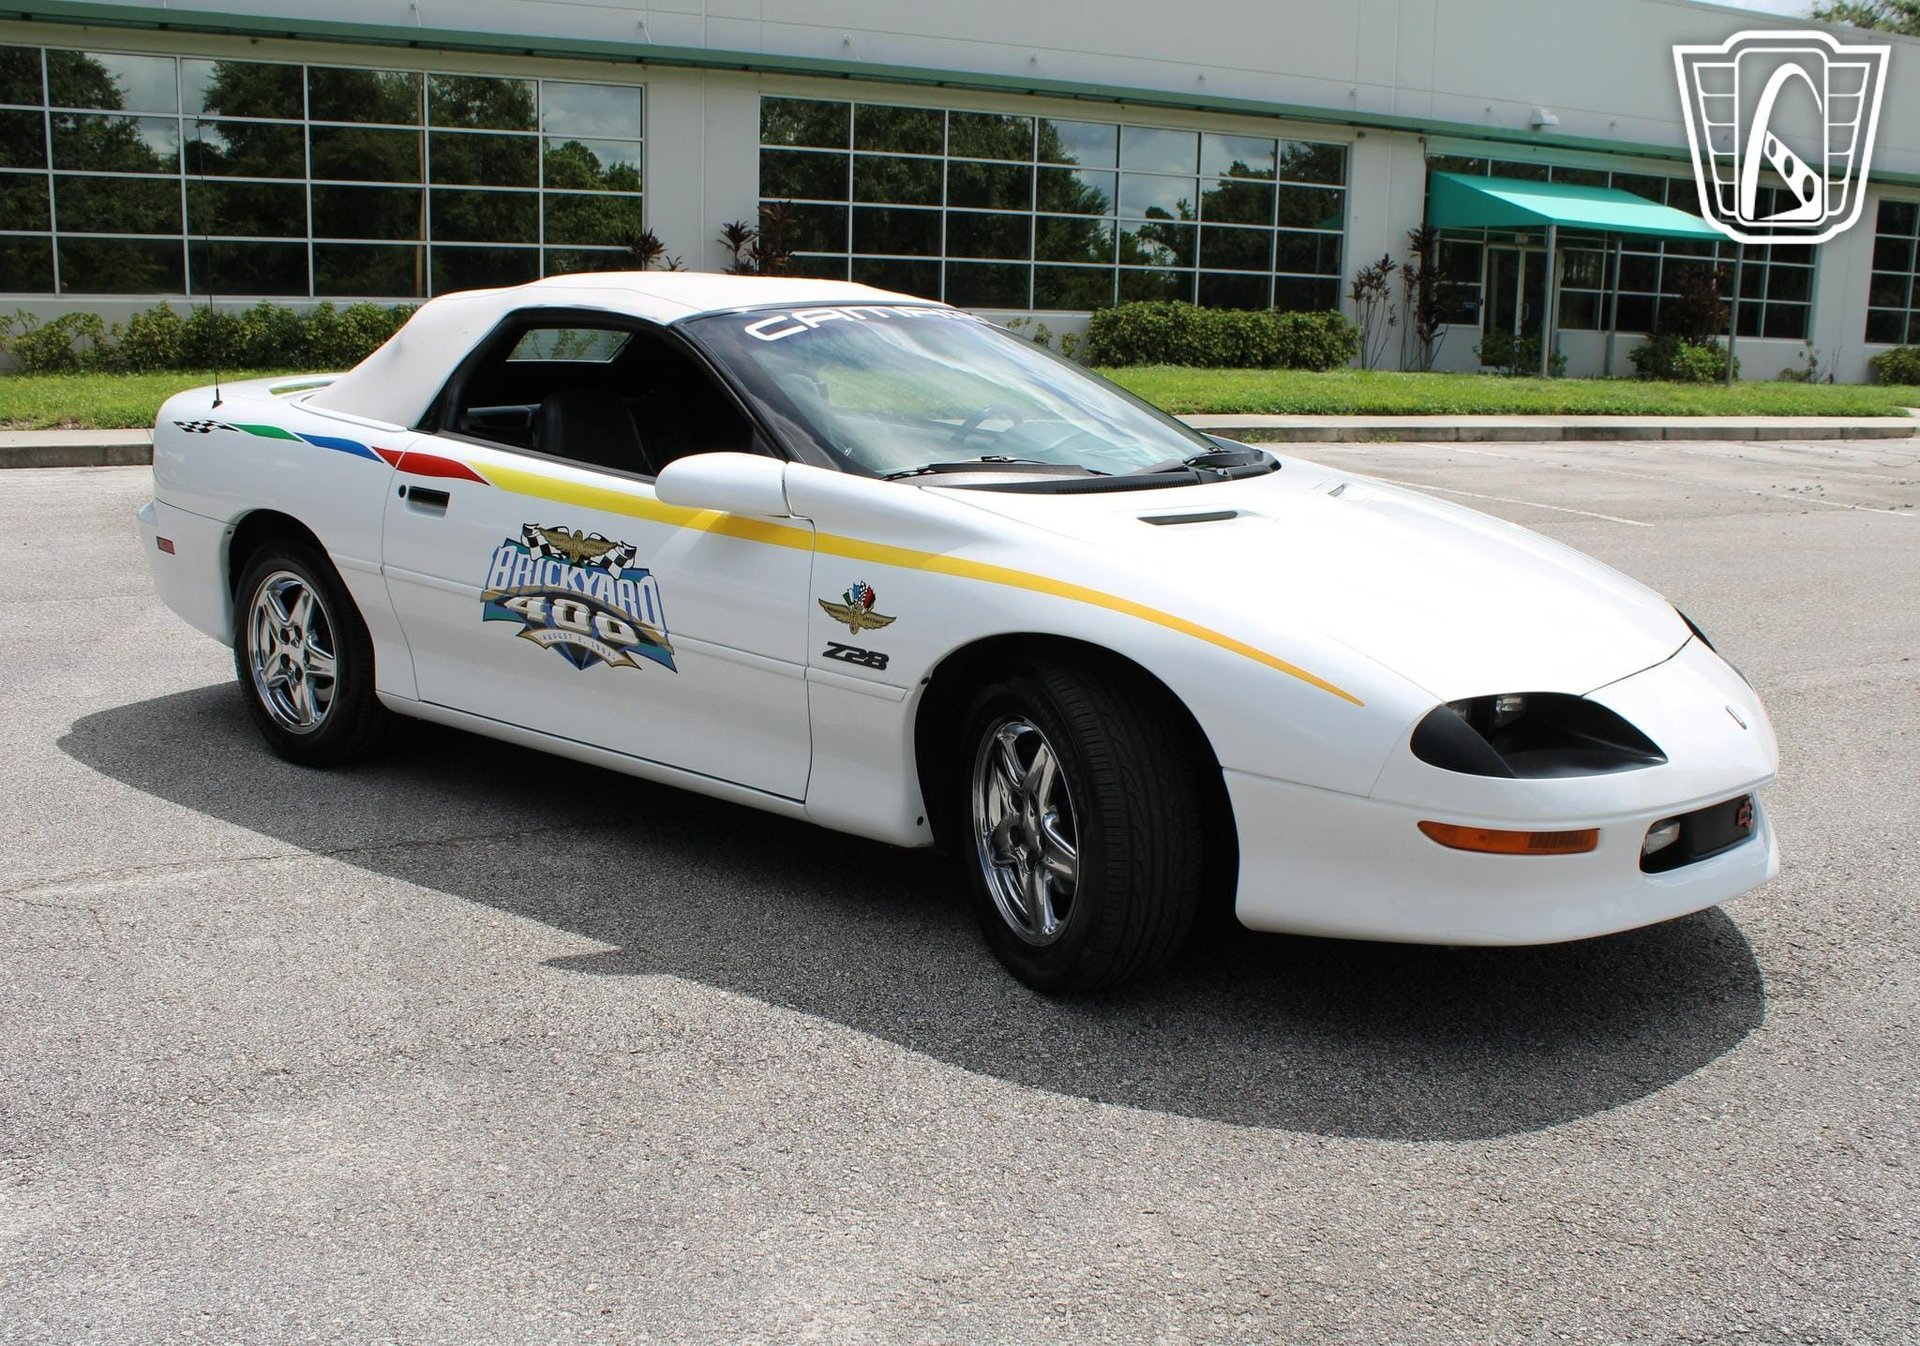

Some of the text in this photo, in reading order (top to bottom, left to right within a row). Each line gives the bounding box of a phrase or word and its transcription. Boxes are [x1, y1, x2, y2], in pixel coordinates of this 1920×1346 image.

[487, 546, 664, 627] BRICKYARD
[504, 596, 640, 646] 400
[822, 641, 890, 671] Z28
